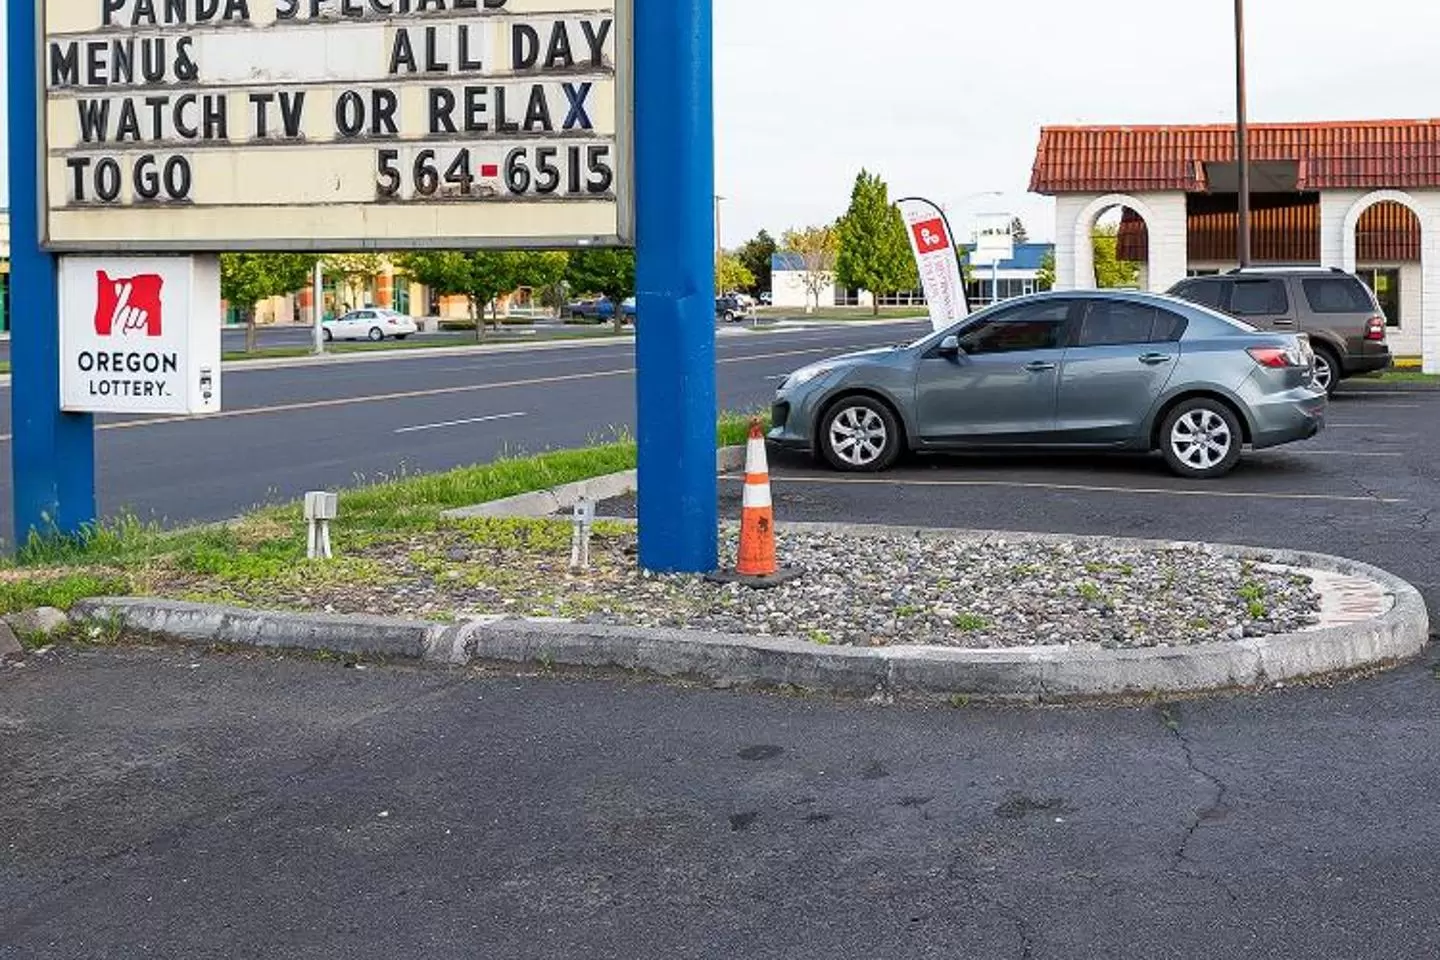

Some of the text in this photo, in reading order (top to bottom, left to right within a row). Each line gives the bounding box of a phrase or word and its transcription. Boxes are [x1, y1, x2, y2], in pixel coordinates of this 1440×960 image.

[389, 23, 482, 74] ALL
[512, 18, 614, 71] DAY
[77, 81, 594, 142] WATCH TV OR RELAX
[66, 145, 615, 202] TO GO 564-6515
[77, 350, 178, 373] OREGON
[88, 378, 167, 397] LOTTERY
